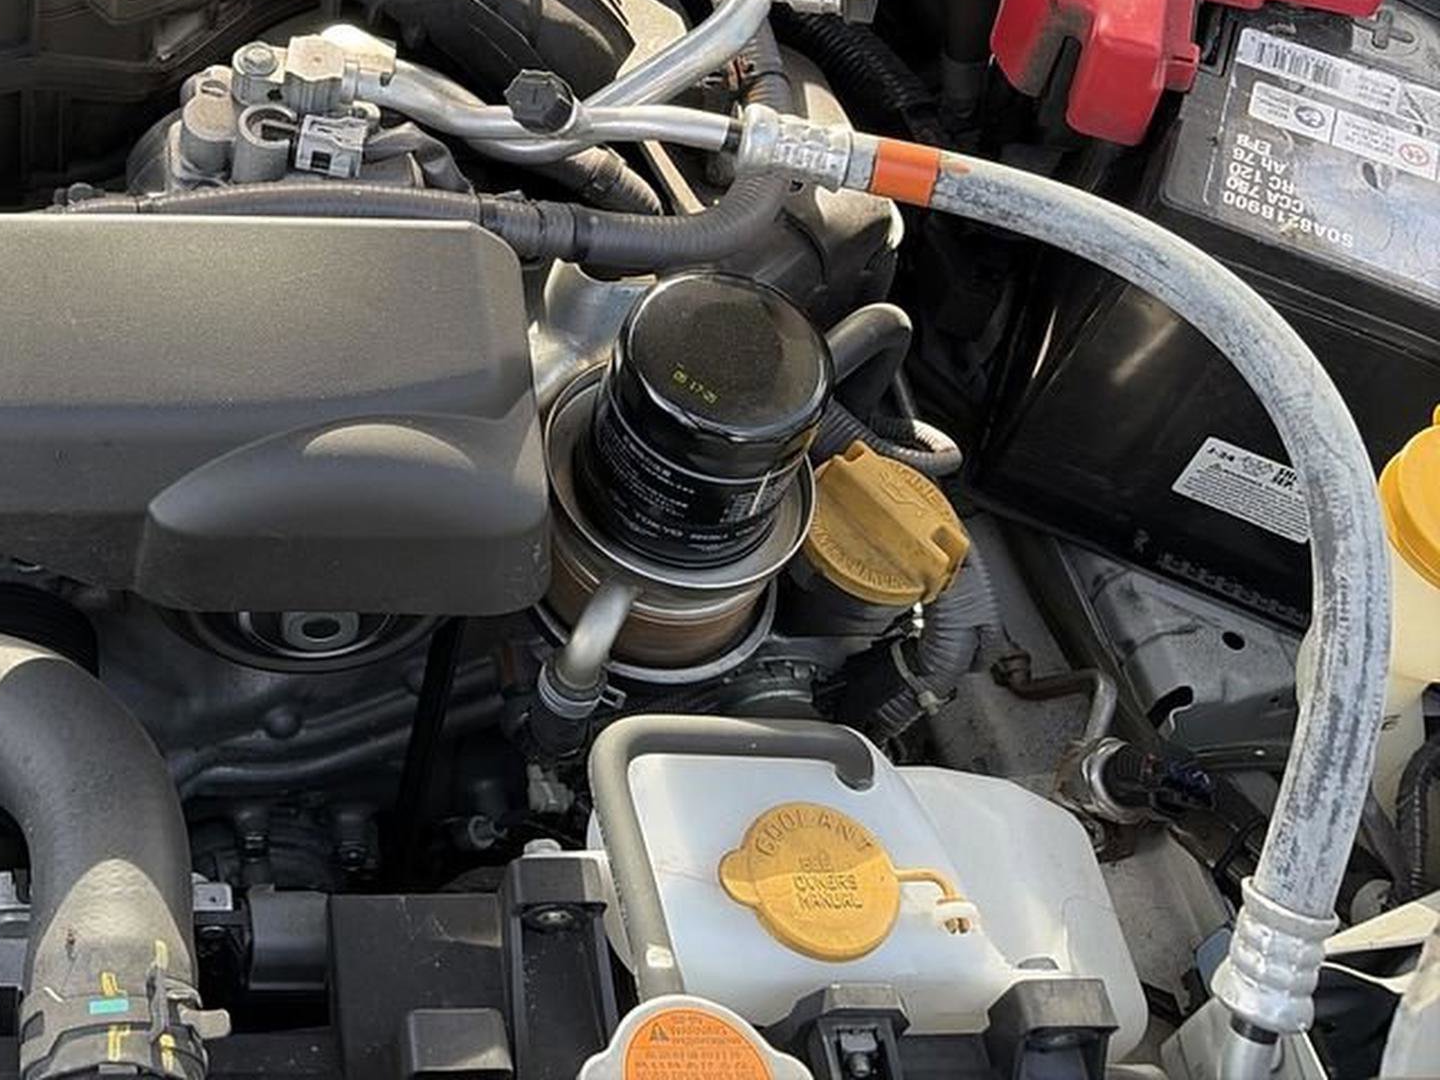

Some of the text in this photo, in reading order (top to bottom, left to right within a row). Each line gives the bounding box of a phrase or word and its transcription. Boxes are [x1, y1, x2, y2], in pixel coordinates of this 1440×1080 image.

[1236, 133, 1272, 156] EFB
[1232, 147, 1288, 175] Ah 76
[1229, 162, 1296, 195] RC 120
[1226, 176, 1304, 214] CCA 750
